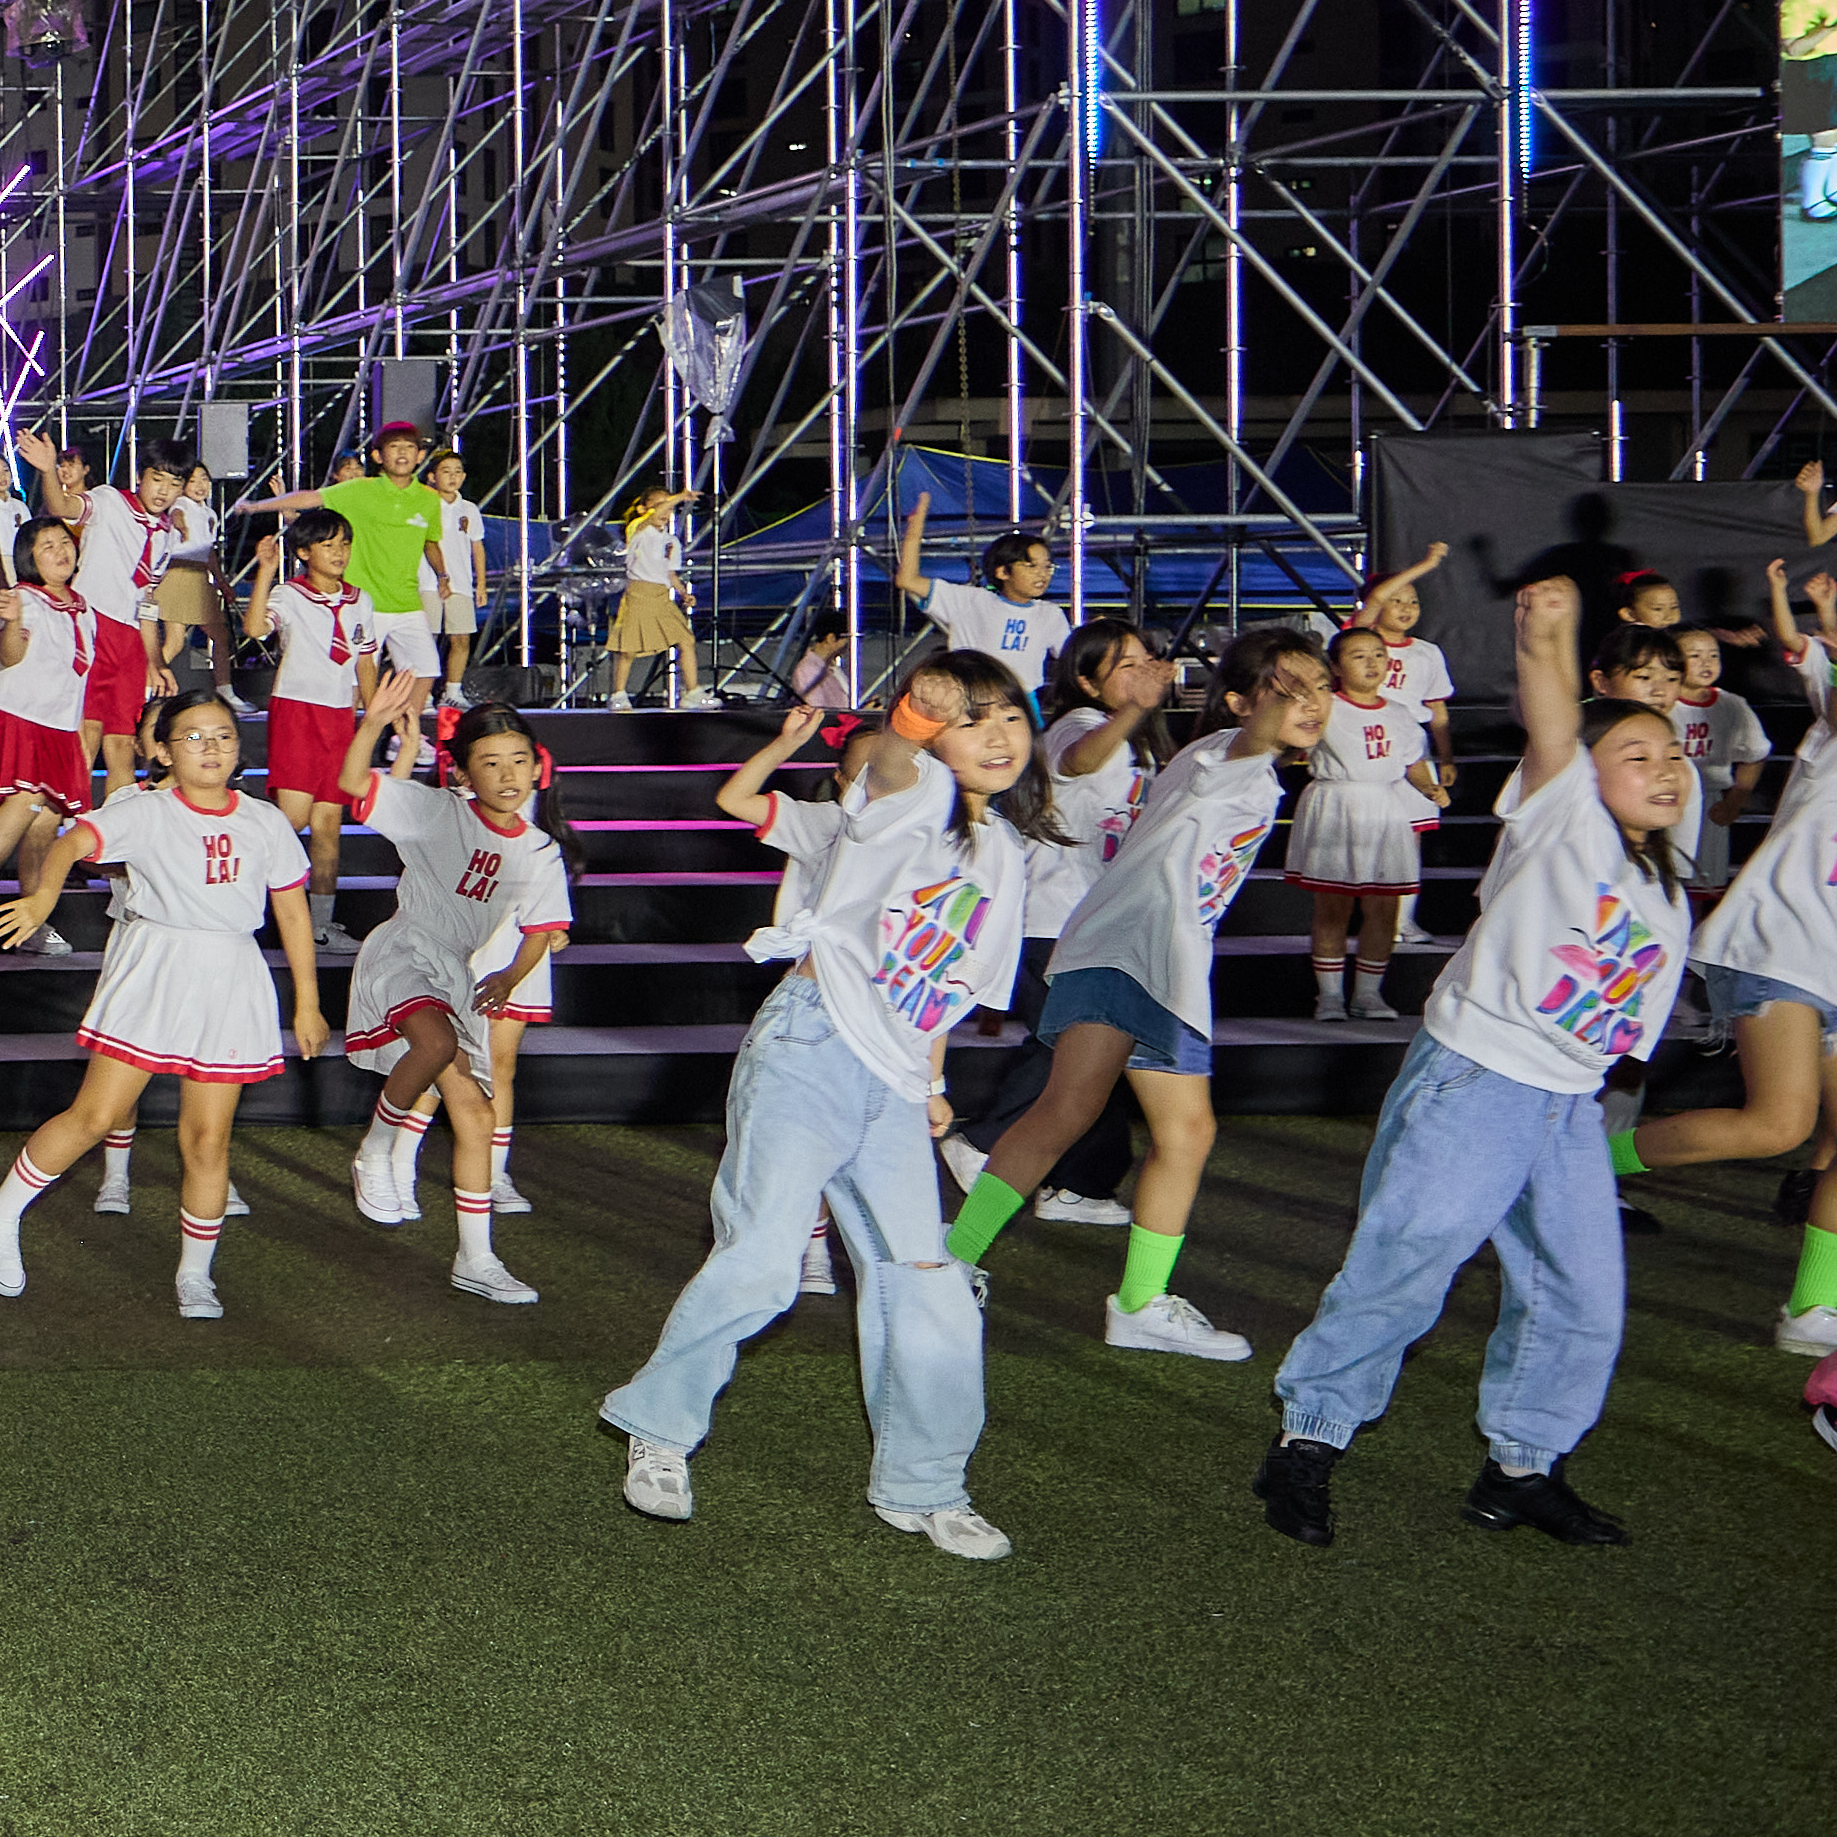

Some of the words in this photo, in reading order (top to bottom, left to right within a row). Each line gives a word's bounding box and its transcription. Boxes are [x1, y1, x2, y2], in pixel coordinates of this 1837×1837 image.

[1005, 618, 1026, 634] HO
[1000, 634, 1029, 651] LA!
[1363, 724, 1384, 741] HO
[1686, 722, 1709, 739] HO
[1365, 740, 1391, 759] LA!
[202, 834, 233, 858] HO
[205, 857, 241, 884] LA!
[467, 848, 502, 877] HO
[455, 870, 499, 903] LA!
